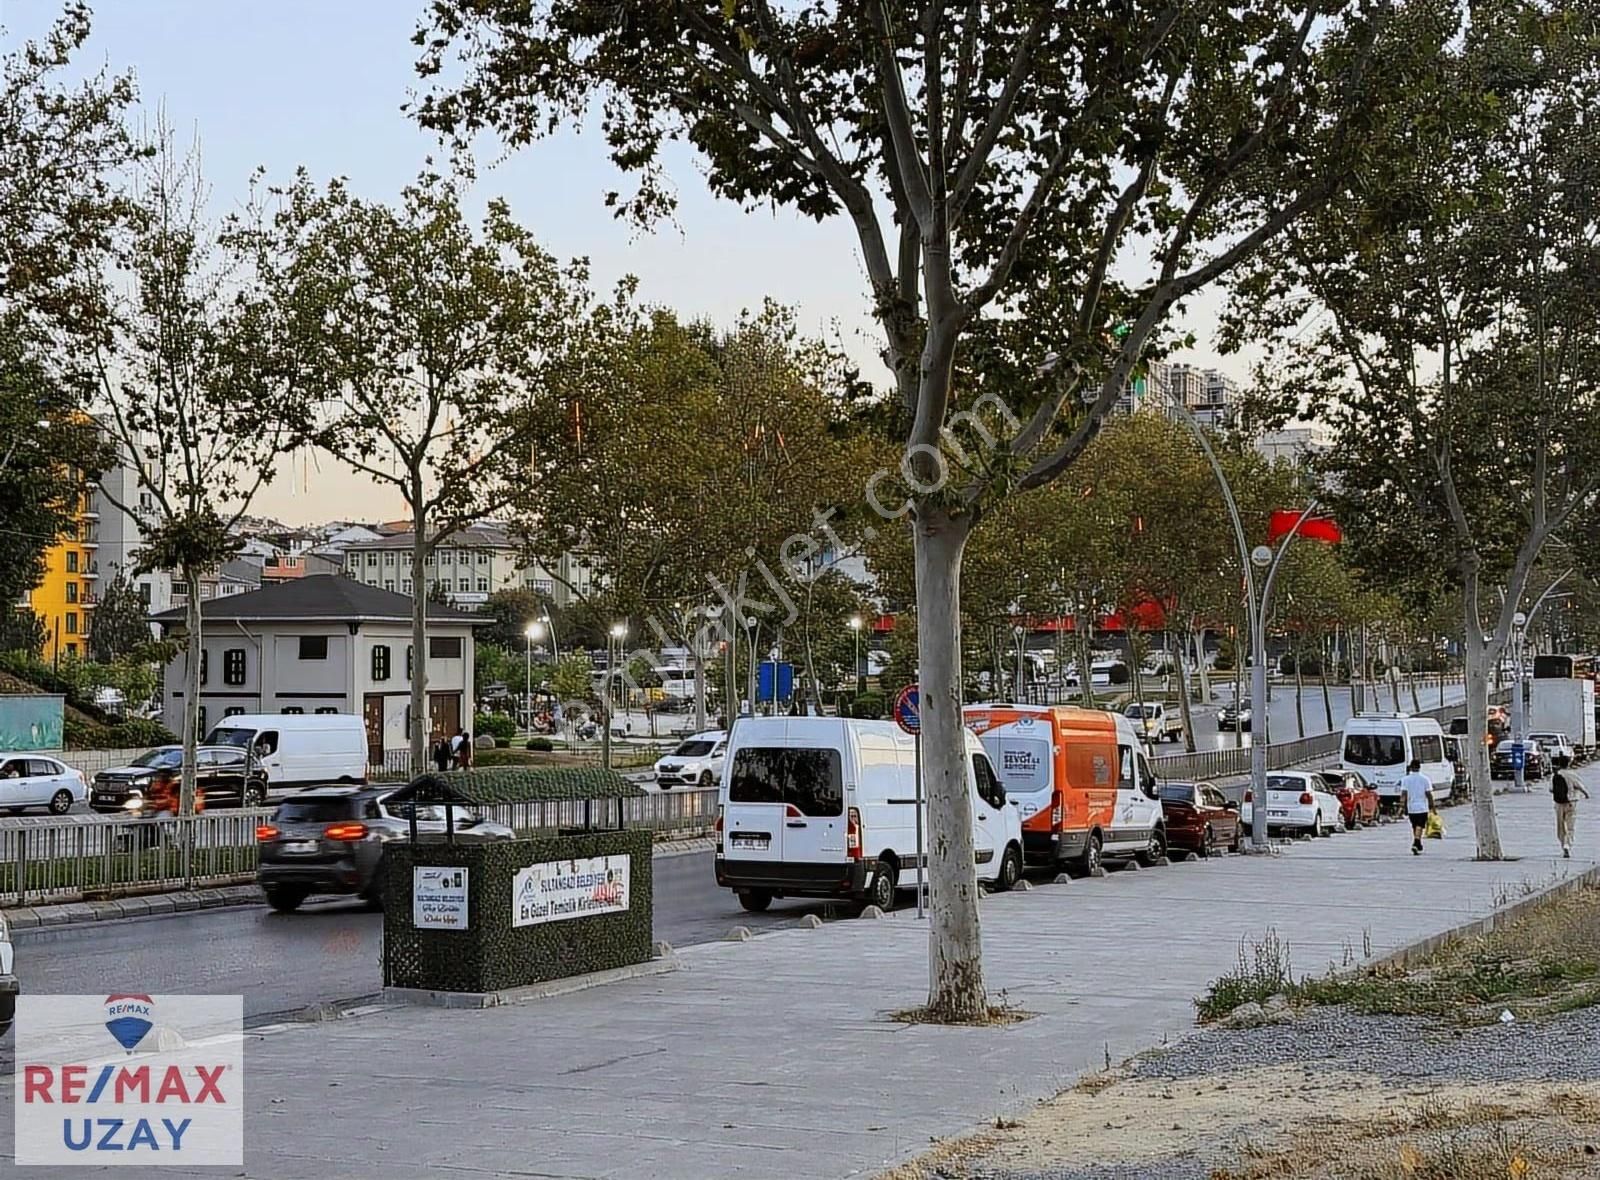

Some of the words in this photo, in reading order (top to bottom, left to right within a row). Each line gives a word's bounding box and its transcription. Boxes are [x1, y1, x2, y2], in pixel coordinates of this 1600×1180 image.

[521, 904, 530, 920] En
[531, 902, 549, 919] Güzel
[550, 898, 576, 916] Temizlik
